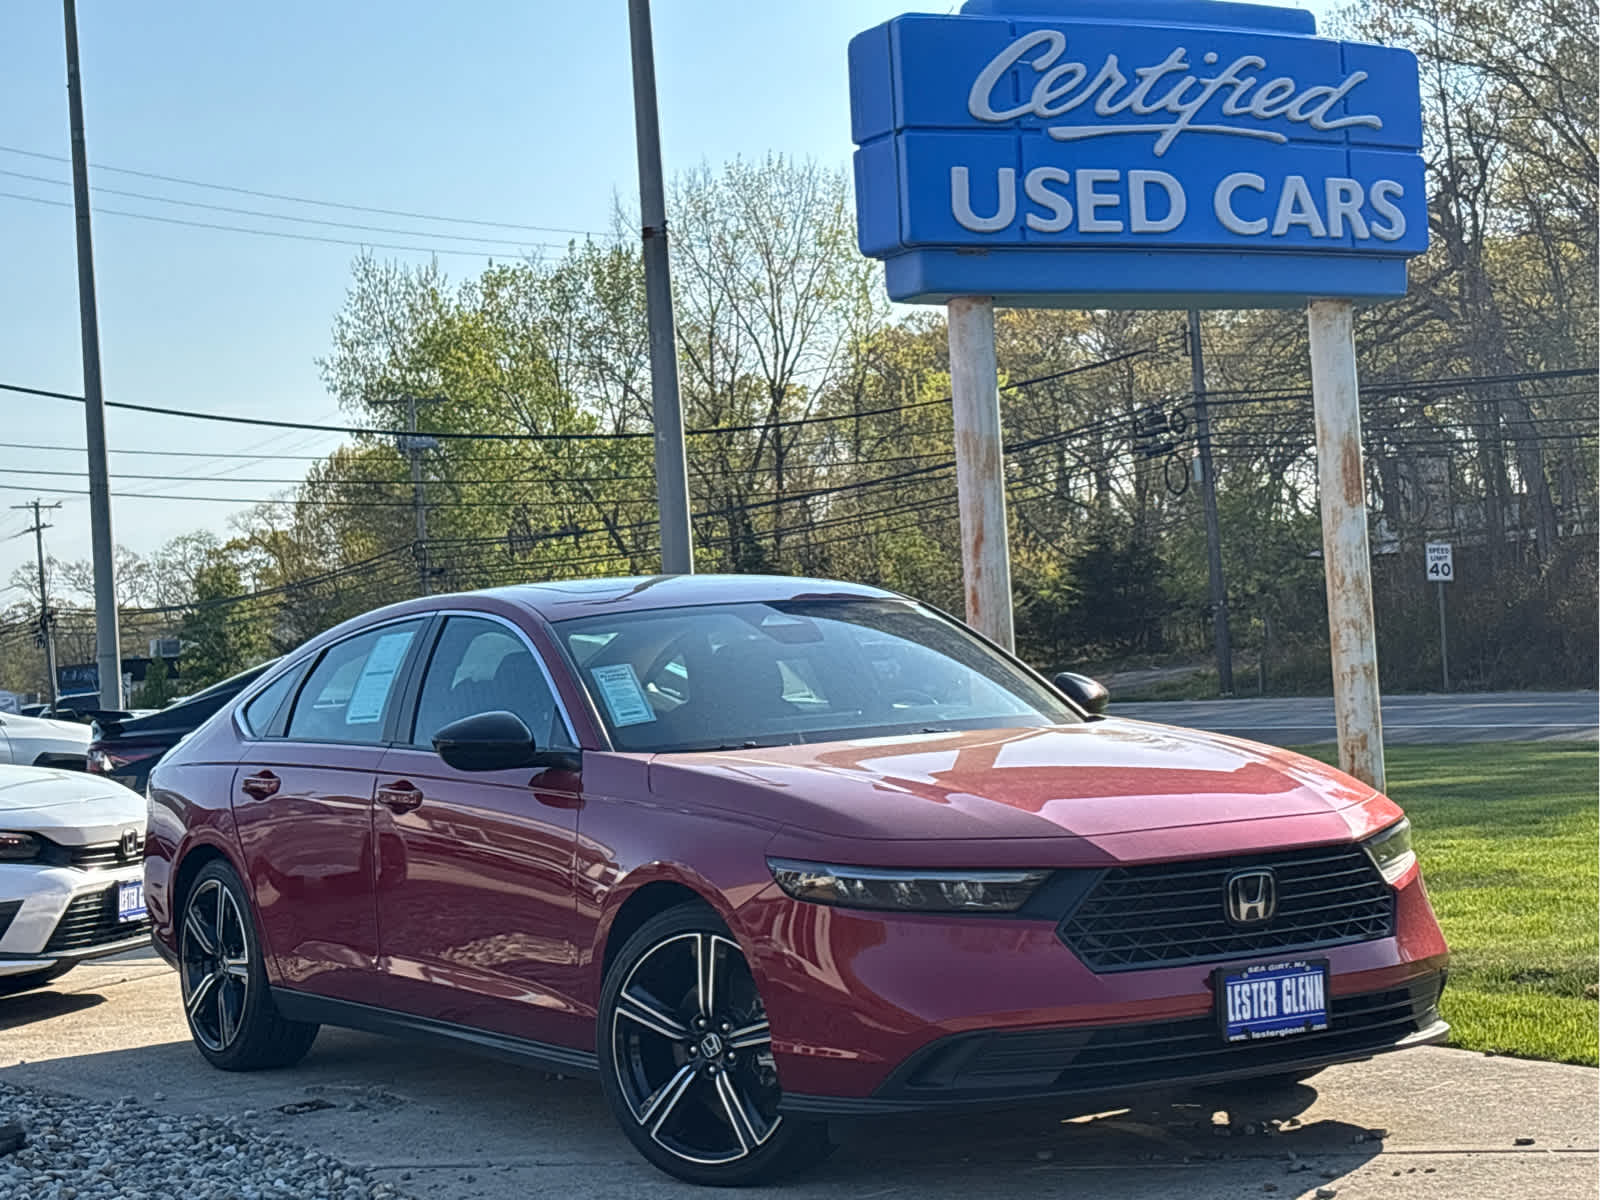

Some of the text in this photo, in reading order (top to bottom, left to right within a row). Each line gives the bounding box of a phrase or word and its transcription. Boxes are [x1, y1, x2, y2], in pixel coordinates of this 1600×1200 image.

[968, 29, 1383, 156] Certified
[950, 166, 1407, 242] USED CARS
[1428, 547, 1449, 555] SPEED
[1429, 562, 1451, 577] 40
[1247, 965, 1266, 974] SEA
[1294, 960, 1306, 968] NJ
[1226, 973, 1325, 1023] LESTER GLENN
